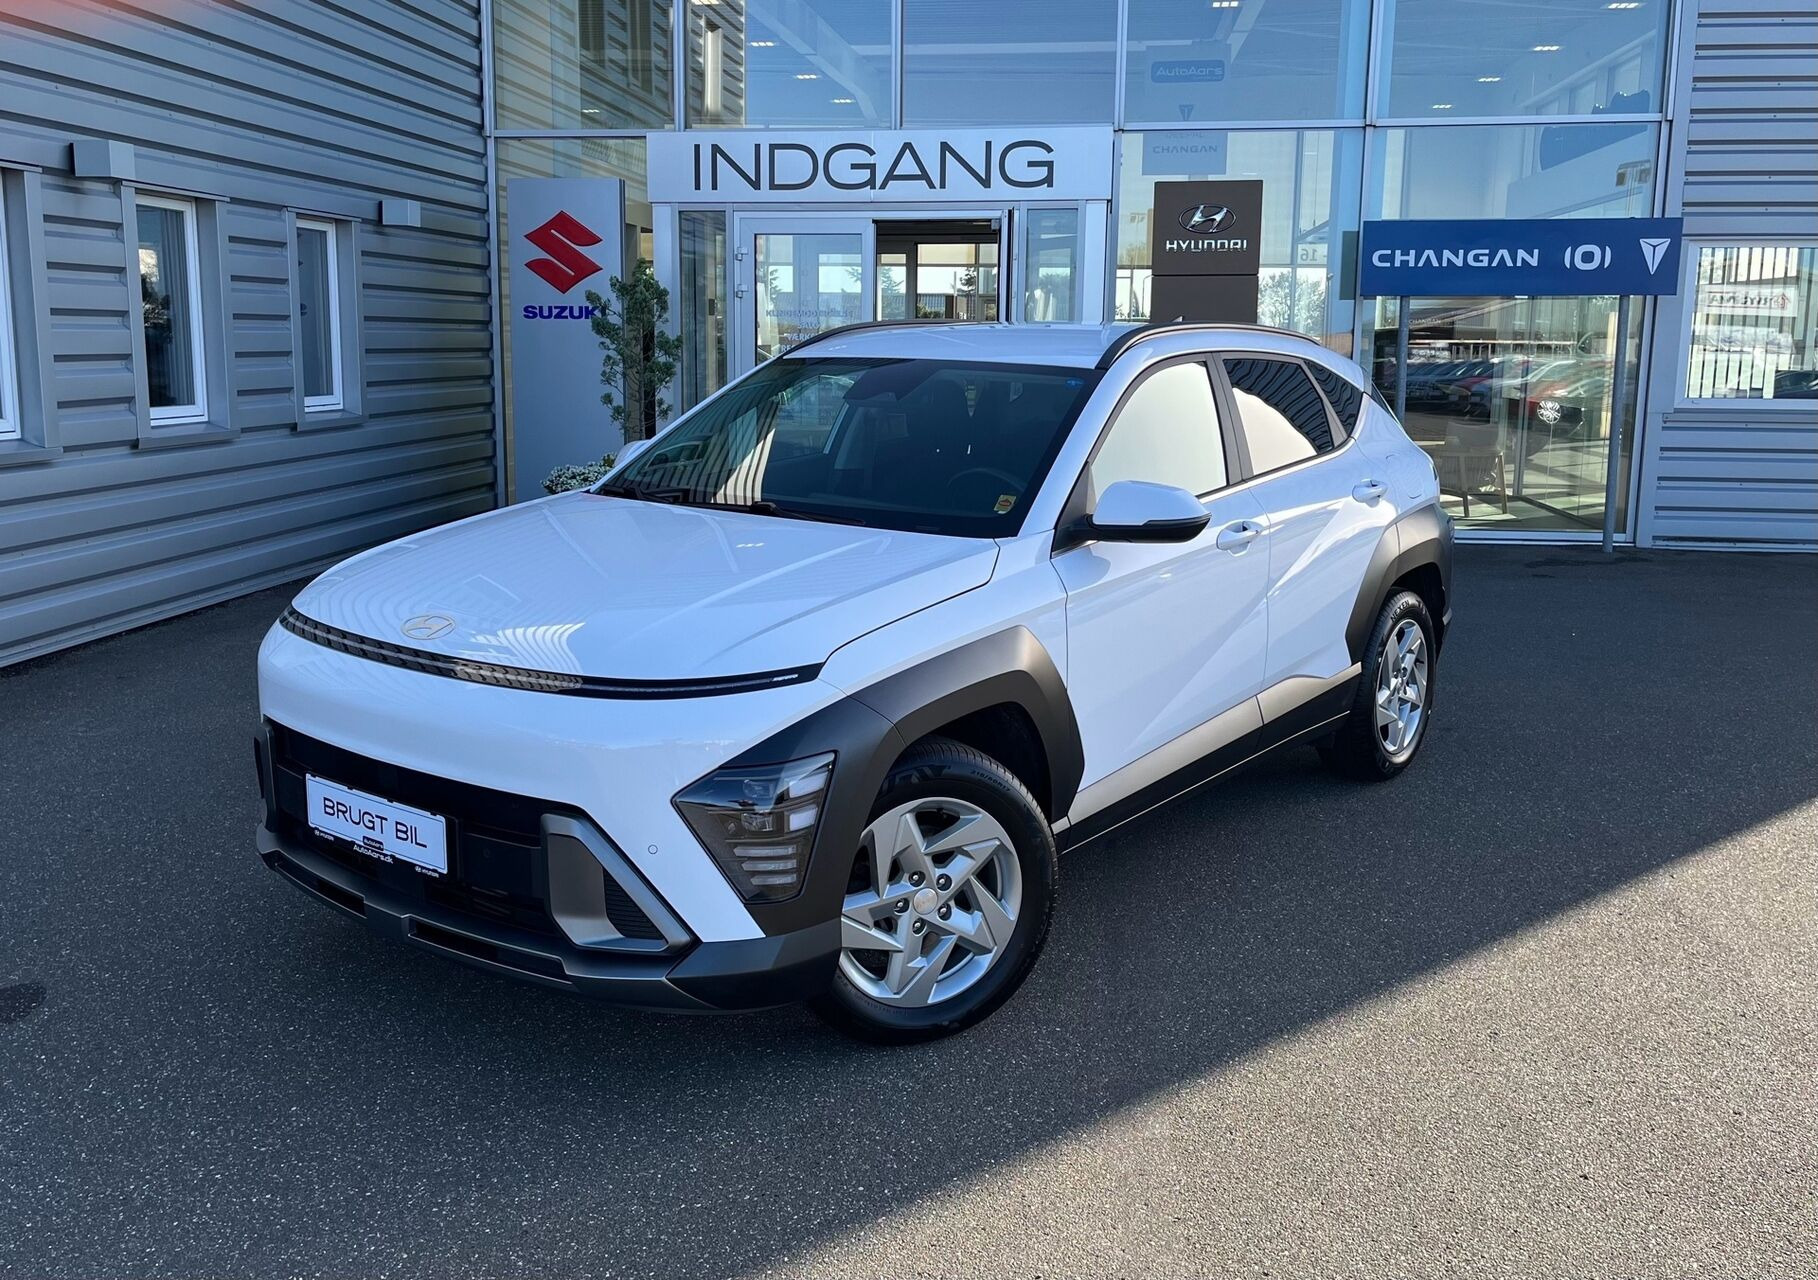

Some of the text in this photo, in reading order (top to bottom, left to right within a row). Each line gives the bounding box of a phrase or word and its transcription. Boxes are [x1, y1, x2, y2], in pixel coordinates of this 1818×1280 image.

[1156, 66, 1223, 76] AutoAars
[1152, 145, 1218, 154] CHANGAN
[693, 140, 1055, 191] INDGANG
[1165, 239, 1248, 252] HYUNDAI
[1372, 248, 1539, 267] CHANGAN
[1391, 600, 1410, 622] NEXEN
[323, 796, 427, 848] BRUGT BIL
